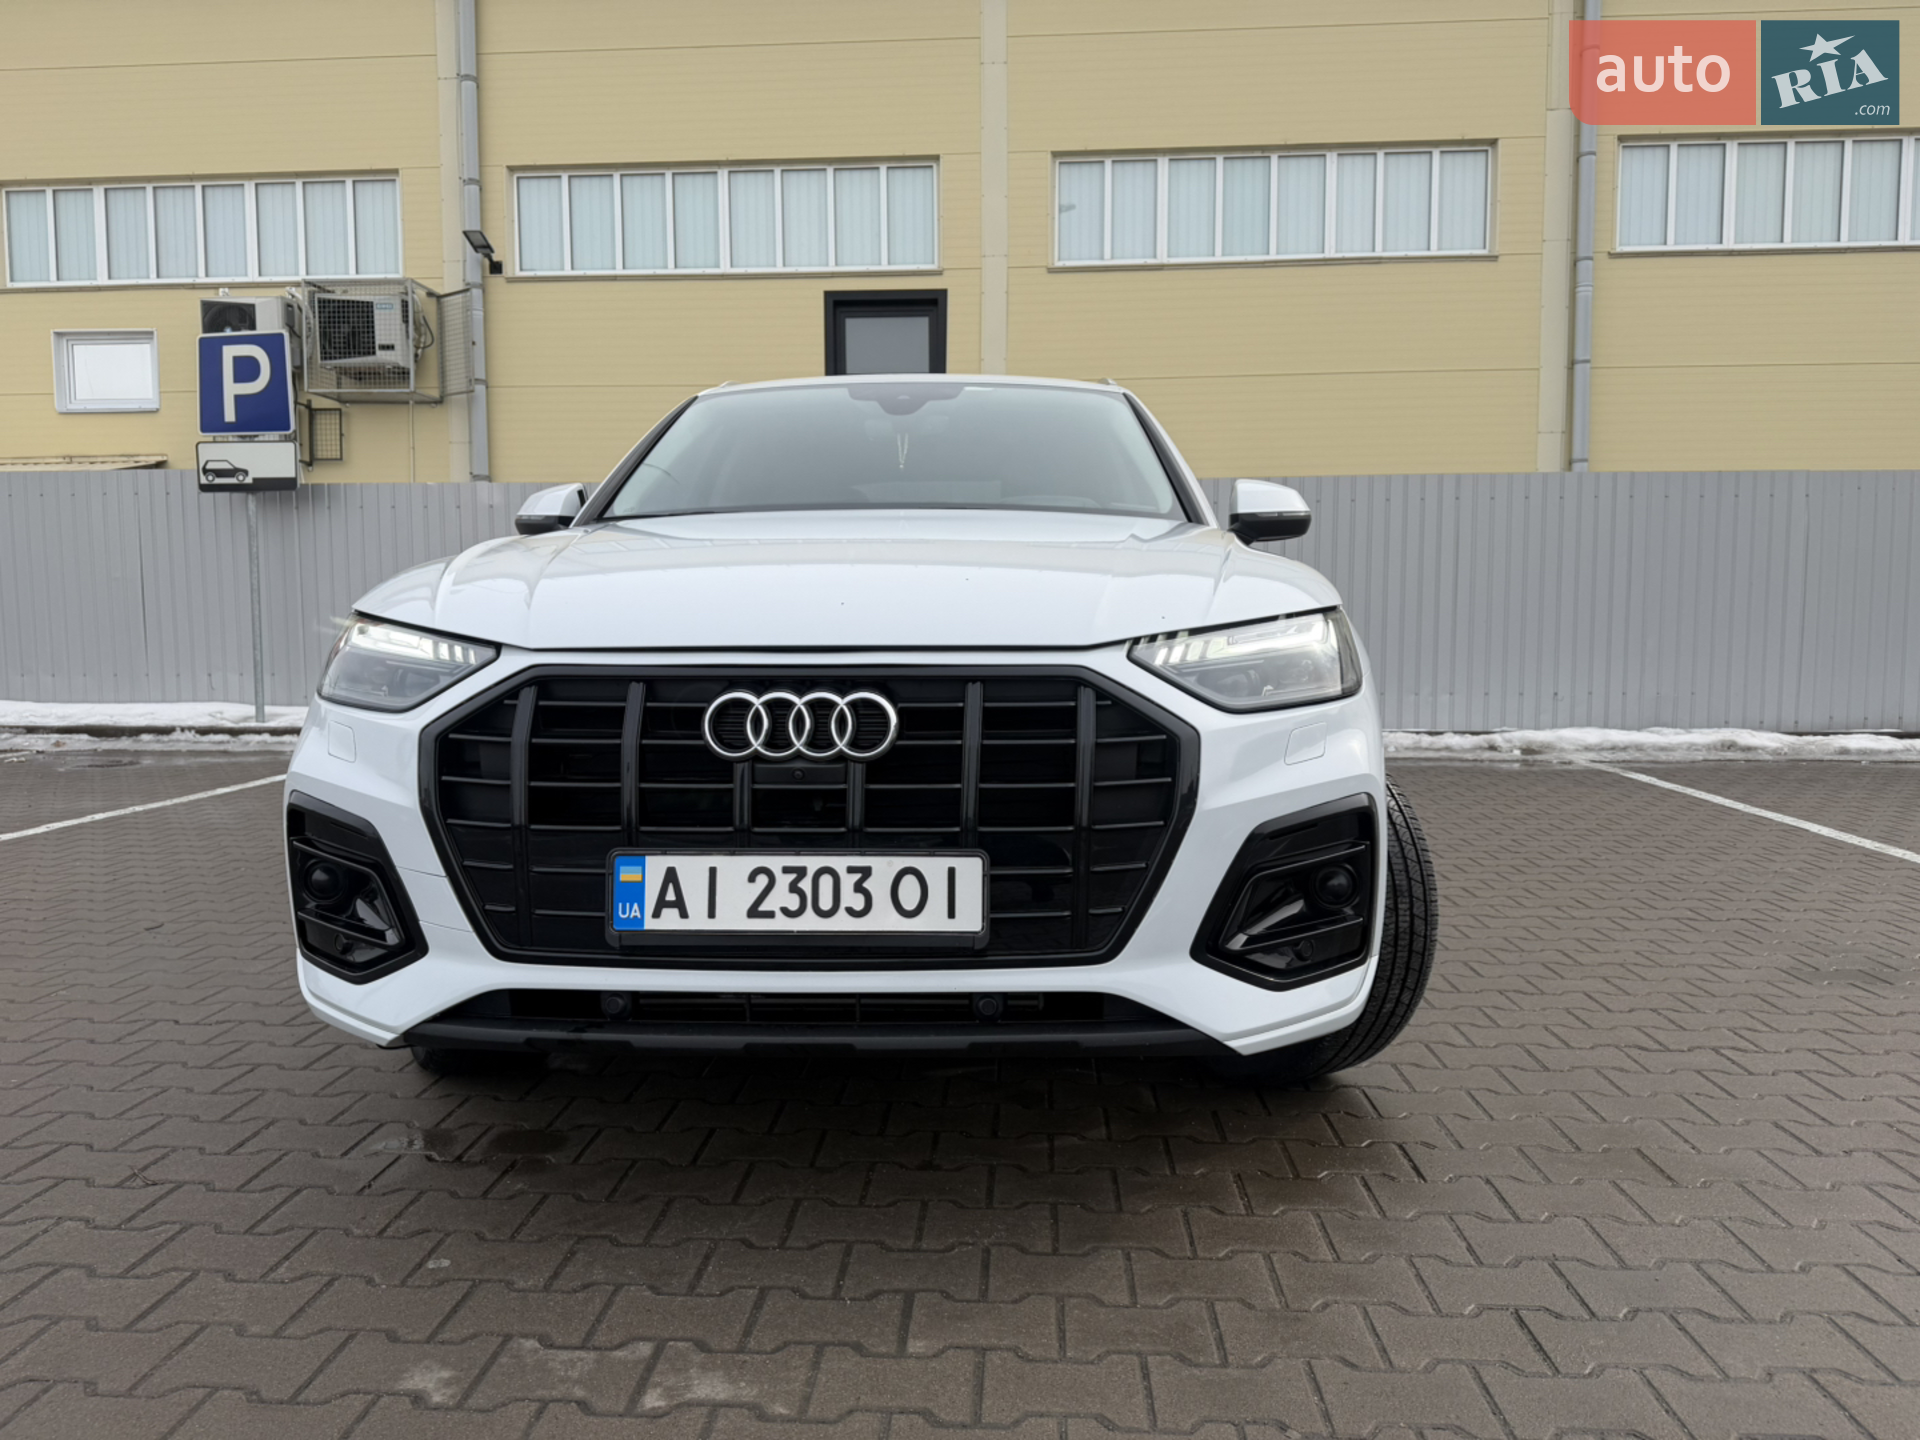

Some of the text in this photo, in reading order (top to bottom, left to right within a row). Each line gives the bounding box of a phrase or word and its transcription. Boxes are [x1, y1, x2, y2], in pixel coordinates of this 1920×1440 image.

[222, 344, 271, 423] P
[618, 903, 641, 919] UA
[746, 865, 873, 919] 2303
